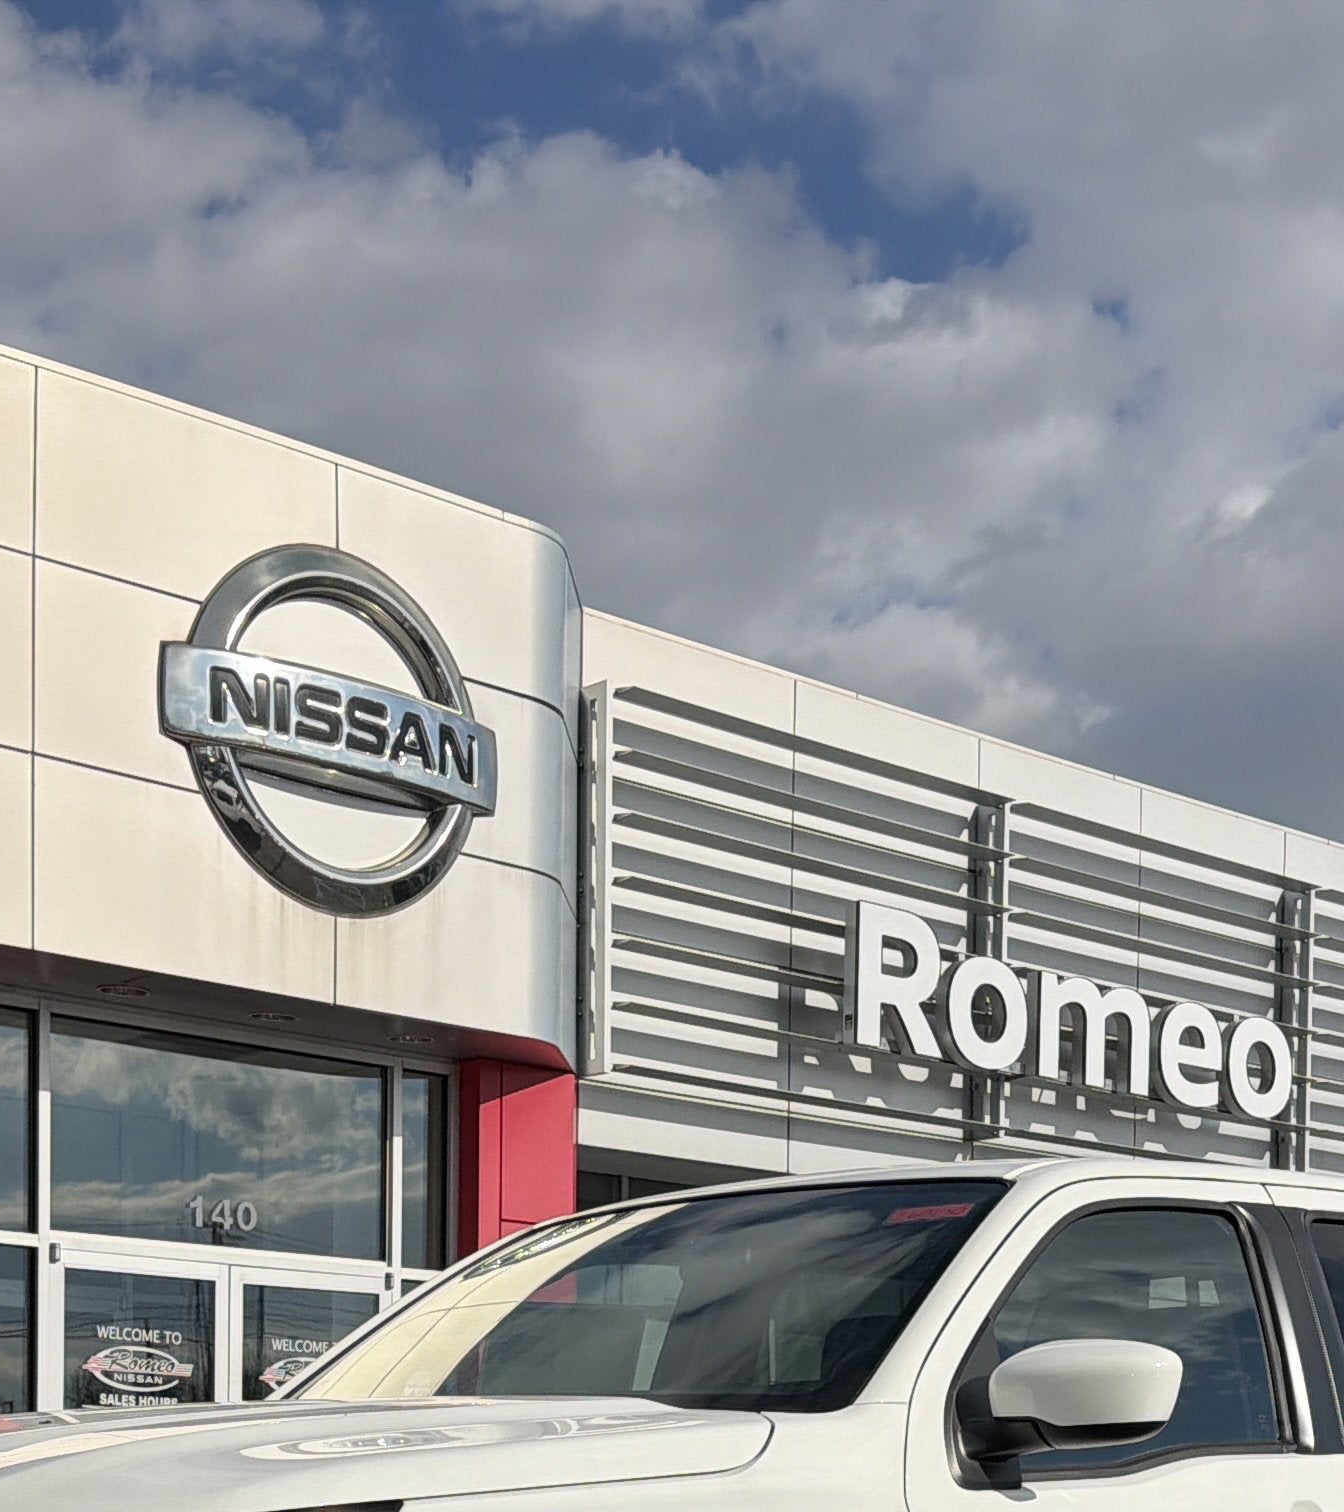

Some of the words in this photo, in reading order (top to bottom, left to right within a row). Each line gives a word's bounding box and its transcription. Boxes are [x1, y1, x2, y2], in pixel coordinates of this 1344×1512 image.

[208, 665, 480, 790] NISSAN
[850, 900, 1293, 1120] Romeo
[189, 1195, 257, 1232] 140
[96, 1324, 161, 1344] WELCOME
[163, 1329, 182, 1346] TO
[271, 1338, 329, 1355] WELCOME
[103, 1348, 176, 1374] Romeo
[112, 1371, 164, 1385] NISSAN
[99, 1393, 136, 1407] SALES
